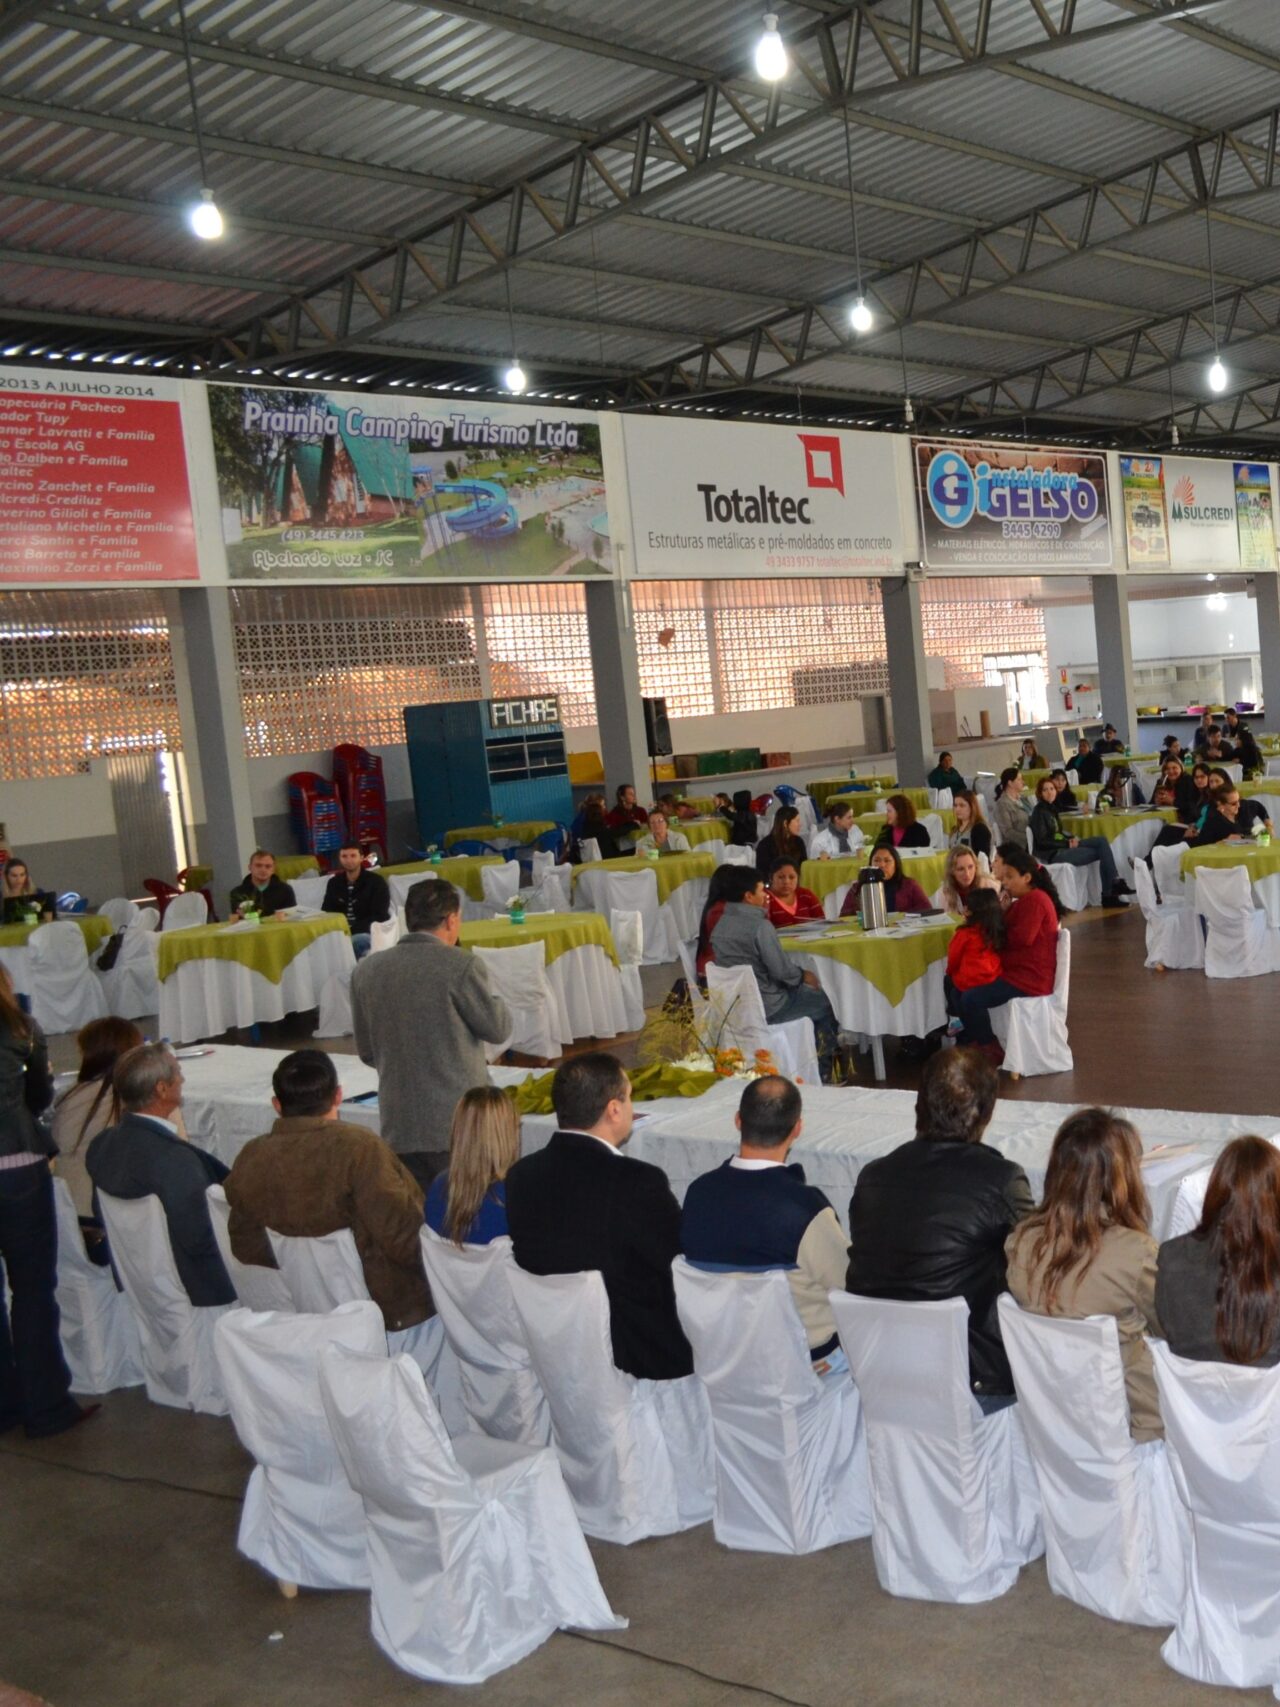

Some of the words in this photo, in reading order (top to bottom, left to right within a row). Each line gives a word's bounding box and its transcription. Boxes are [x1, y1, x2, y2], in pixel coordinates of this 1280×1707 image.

[0, 378, 40, 390] 2013
[45, 381, 56, 391] A
[59, 382, 111, 394] JULHO
[115, 386, 155, 396] 2014
[71, 400, 126, 413] Pacheco
[36, 412, 70, 425] Tupy
[243, 400, 339, 435] Prainha
[345, 407, 444, 447] Camping
[450, 413, 531, 445] Turismo
[536, 419, 579, 447] Ltda
[38, 426, 92, 438] Lavratti
[96, 431, 104, 439] e
[14, 438, 59, 450] Escola
[64, 440, 85, 451] AG
[16, 451, 63, 464] Dalben
[67, 456, 76, 465] e
[38, 480, 93, 492] Zanchet
[96, 484, 104, 493] e
[697, 483, 811, 524] Totaltec
[987, 478, 1097, 519] GELSO
[51, 507, 89, 519] Gilioli
[92, 511, 100, 519] e
[1184, 506, 1234, 521] SULCREDI
[56, 521, 112, 532] Michelin
[115, 524, 124, 532] e
[1003, 522, 1031, 537] 3445
[1033, 523, 1061, 538] 4299
[30, 534, 74, 546] Santin
[78, 537, 86, 545] e
[281, 529, 305, 543] (49)
[310, 529, 336, 541] 3445
[648, 531, 704, 549] Estruturas
[707, 532, 757, 550] metálicas
[759, 538, 765, 549] e
[768, 534, 834, 553] pré-moldados
[837, 539, 851, 550] em
[854, 536, 892, 550] concreto
[937, 540, 972, 549] MATERIAIS
[81, 551, 89, 559] e
[252, 549, 331, 571] Abelardo
[954, 553, 977, 561] VENDA
[64, 561, 100, 573] Zorzi
[104, 563, 112, 572] e
[491, 698, 558, 725] FICHAS
